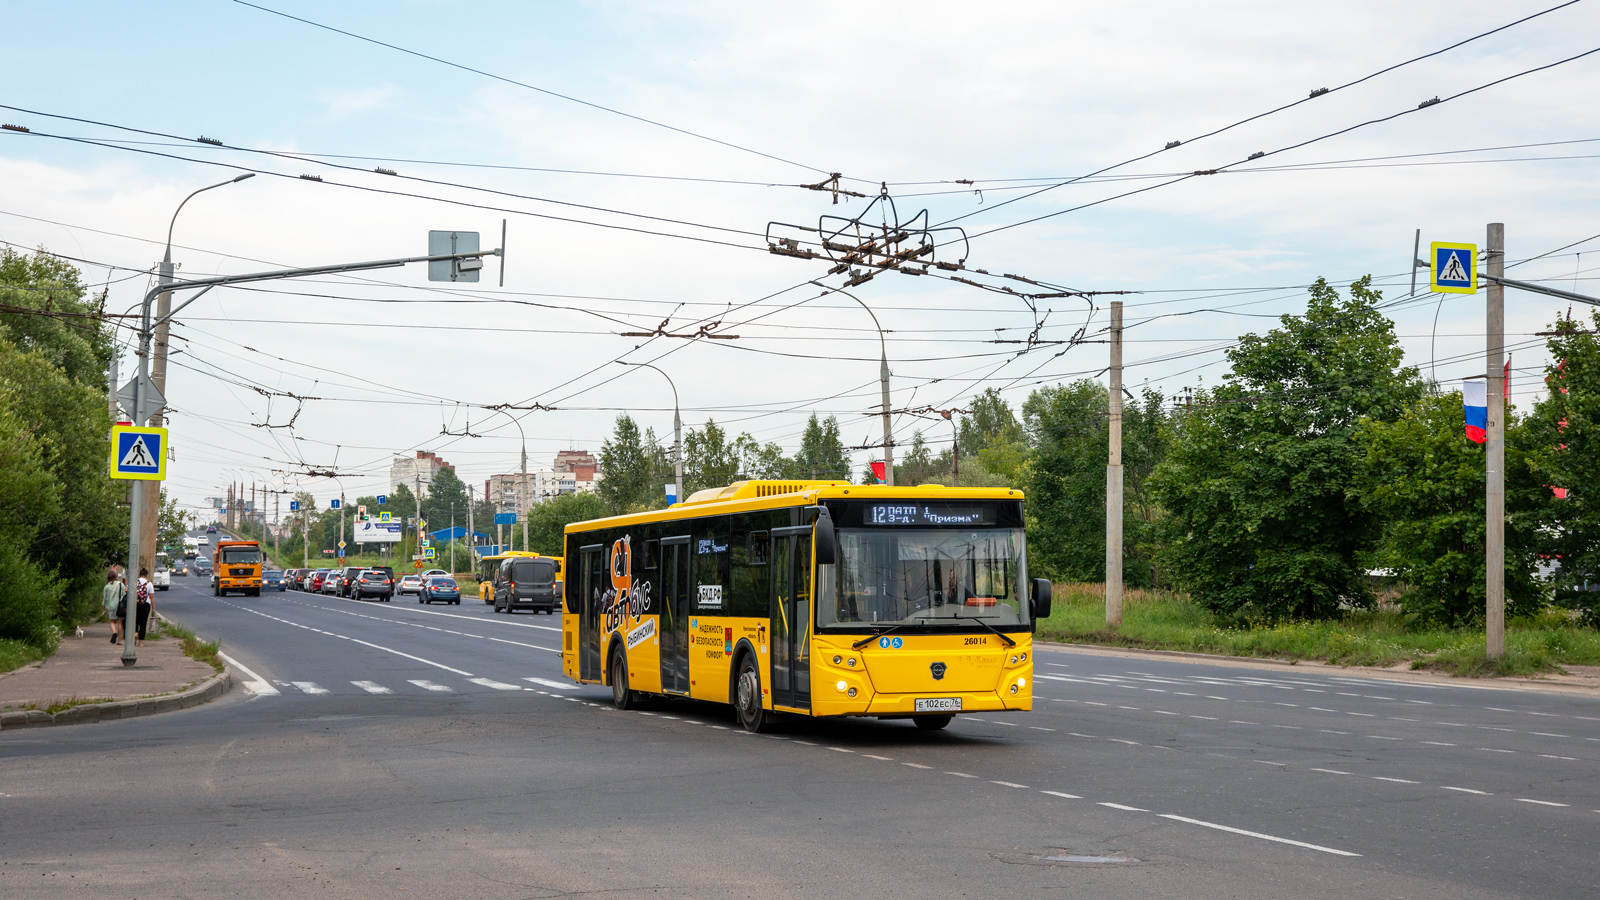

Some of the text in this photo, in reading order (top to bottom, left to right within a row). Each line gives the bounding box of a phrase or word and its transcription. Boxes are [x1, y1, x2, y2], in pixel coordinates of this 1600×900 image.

[873, 506, 886, 523] 12
[888, 506, 930, 515] ПАТП 1
[924, 514, 979, 523] "Призма"
[702, 588, 721, 602] БКД.РФ
[627, 618, 655, 649] РЫБИНСКИЙ
[699, 624, 723, 634] НАДЕЖНОСТЬ
[696, 636, 723, 647] БЕЗОПАСНОСТЬ
[964, 638, 987, 646] 26014
[706, 650, 723, 659] КОМФОРТ
